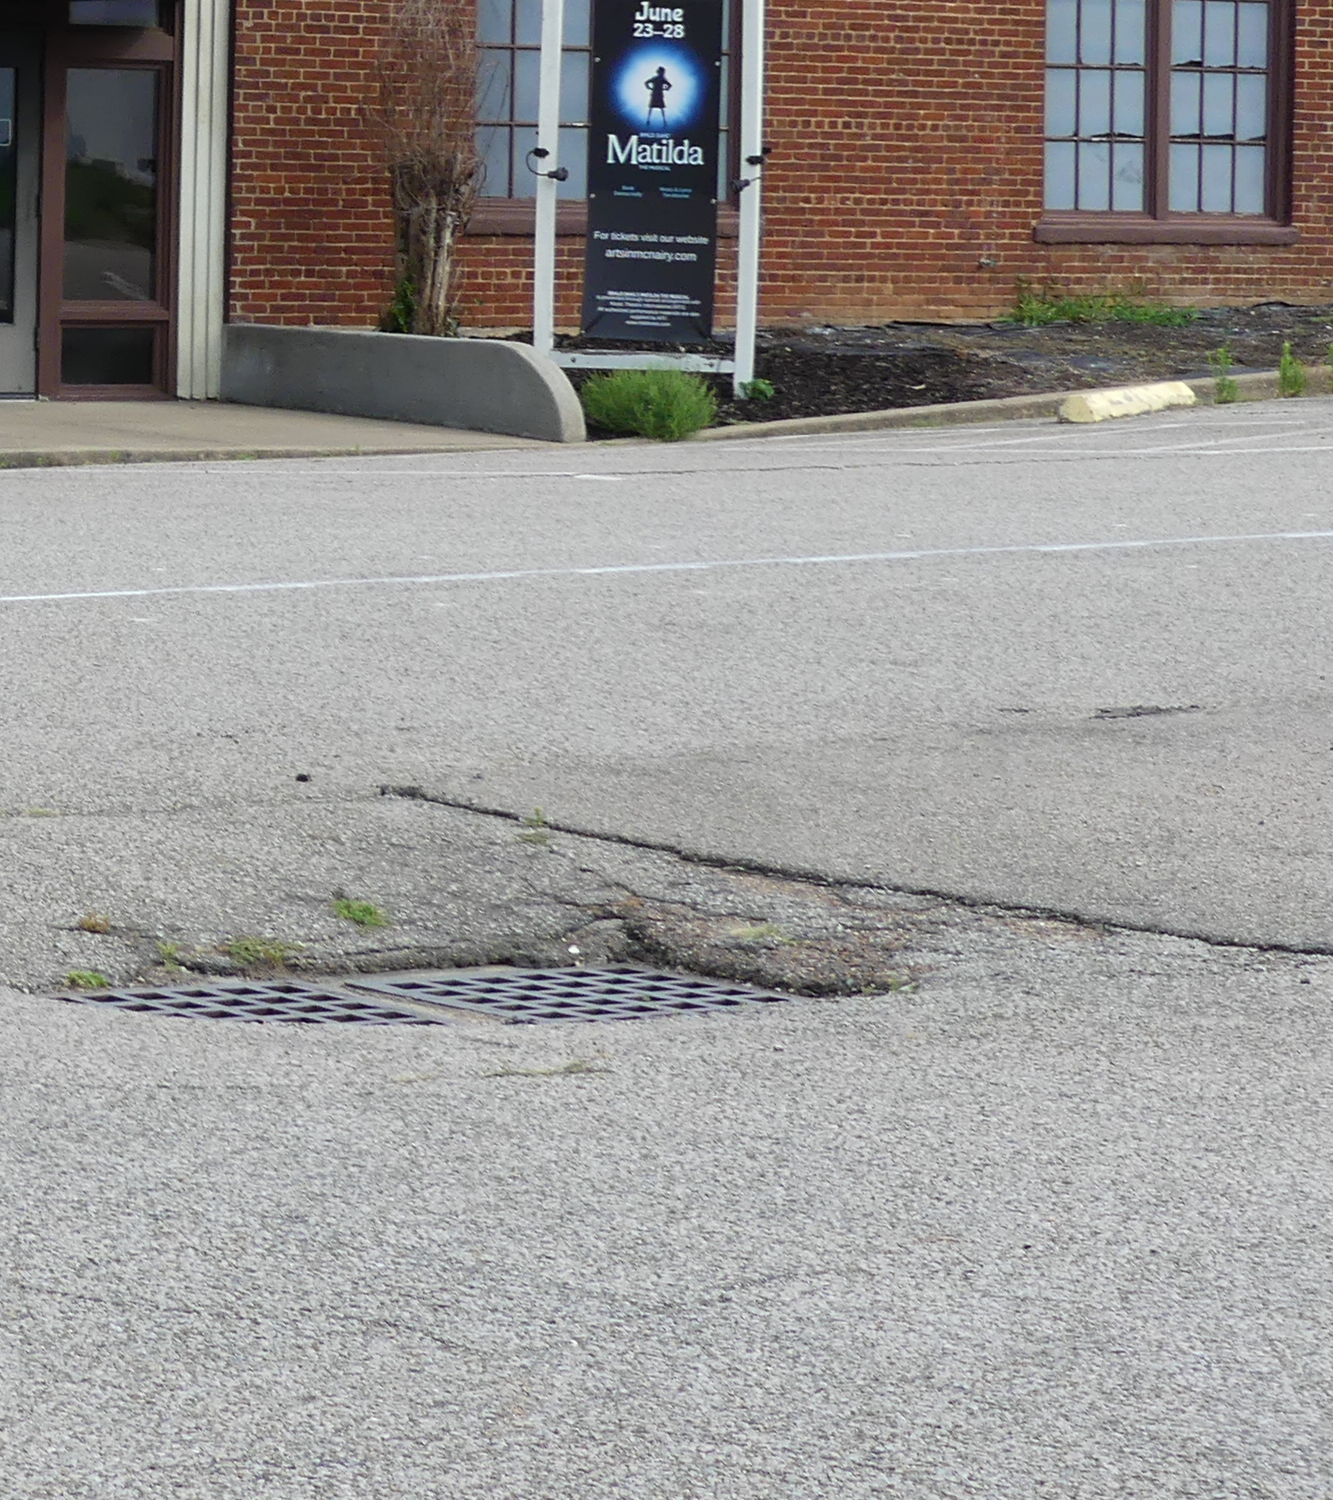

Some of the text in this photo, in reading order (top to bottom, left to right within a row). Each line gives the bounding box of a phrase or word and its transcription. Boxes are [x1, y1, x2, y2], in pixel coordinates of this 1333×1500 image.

[635, 1, 684, 21] June
[606, 133, 705, 165] Matilda
[593, 230, 709, 244] For tickets visit our website
[605, 248, 697, 262] artsinmcnairy.com
